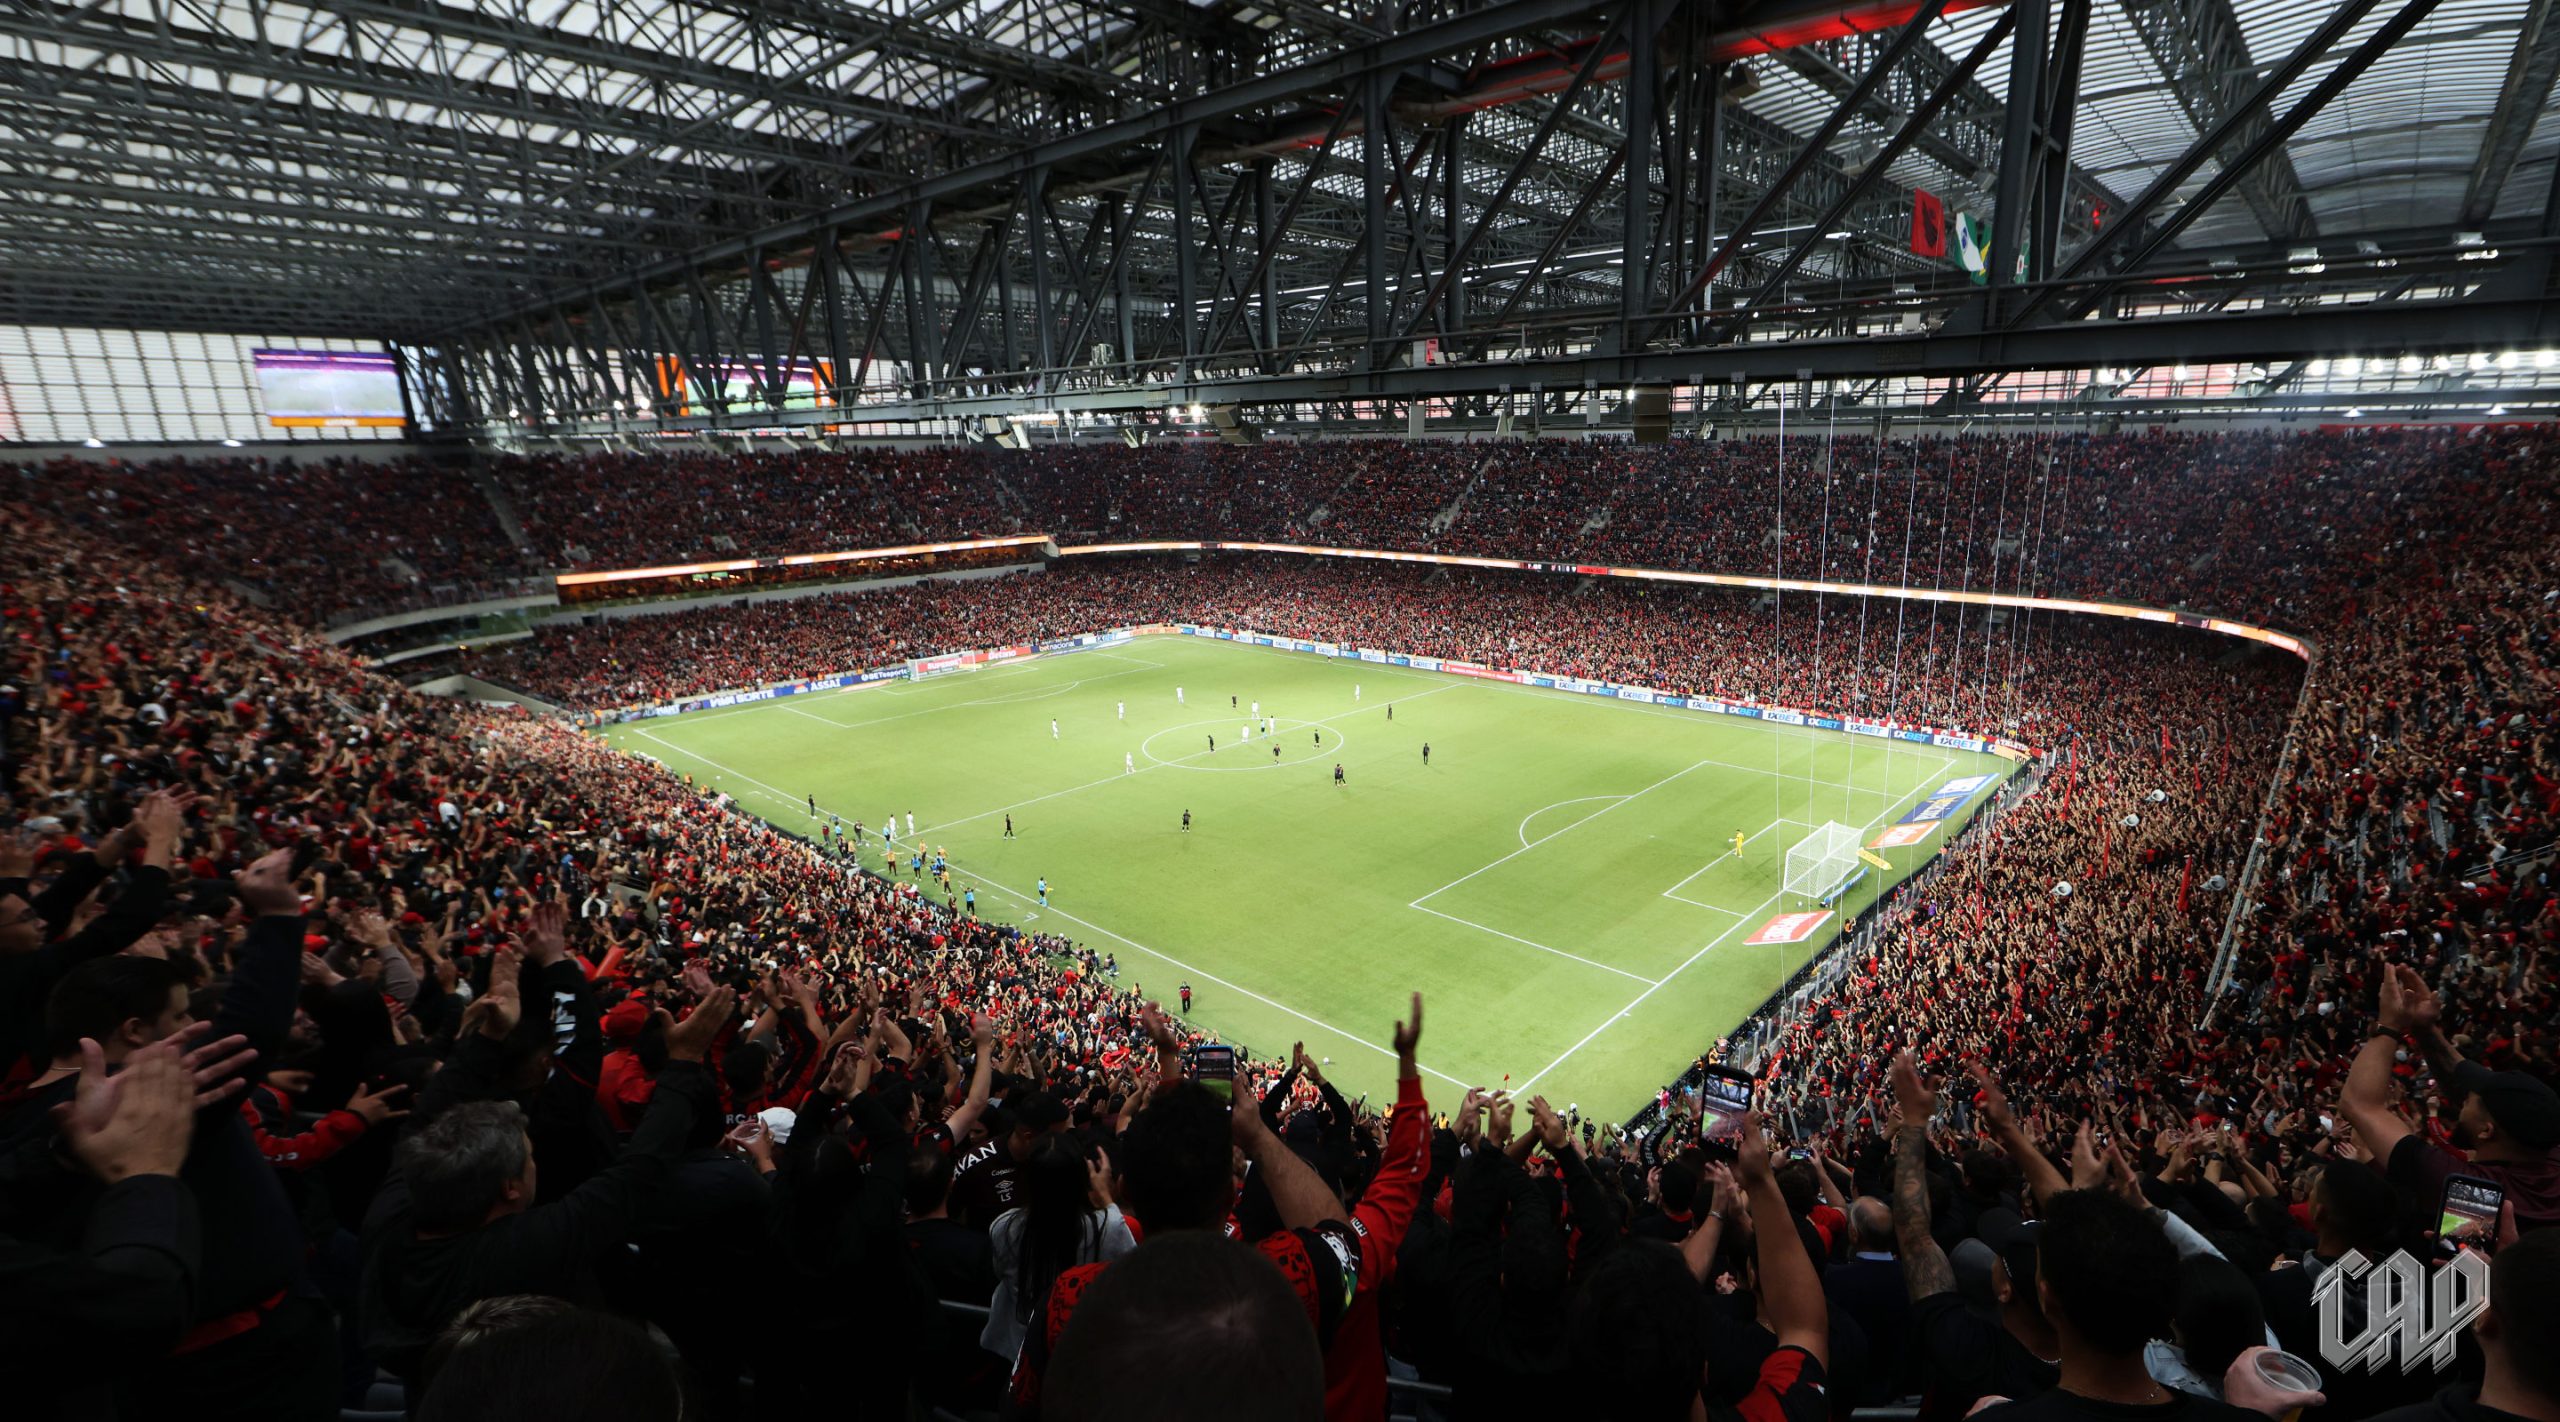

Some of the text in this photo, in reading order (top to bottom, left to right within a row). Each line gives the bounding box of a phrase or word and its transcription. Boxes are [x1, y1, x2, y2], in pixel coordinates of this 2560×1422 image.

[1728, 706, 1759, 717] 1XBET
[1767, 711, 1797, 723] 1XBET
[1808, 717, 1840, 729] 1XBET
[1850, 722, 1884, 735] 1XBET
[1893, 729, 1929, 742] 1XBET
[1939, 736, 1976, 749] 1XBET
[952, 1141, 997, 1182] AVAN
